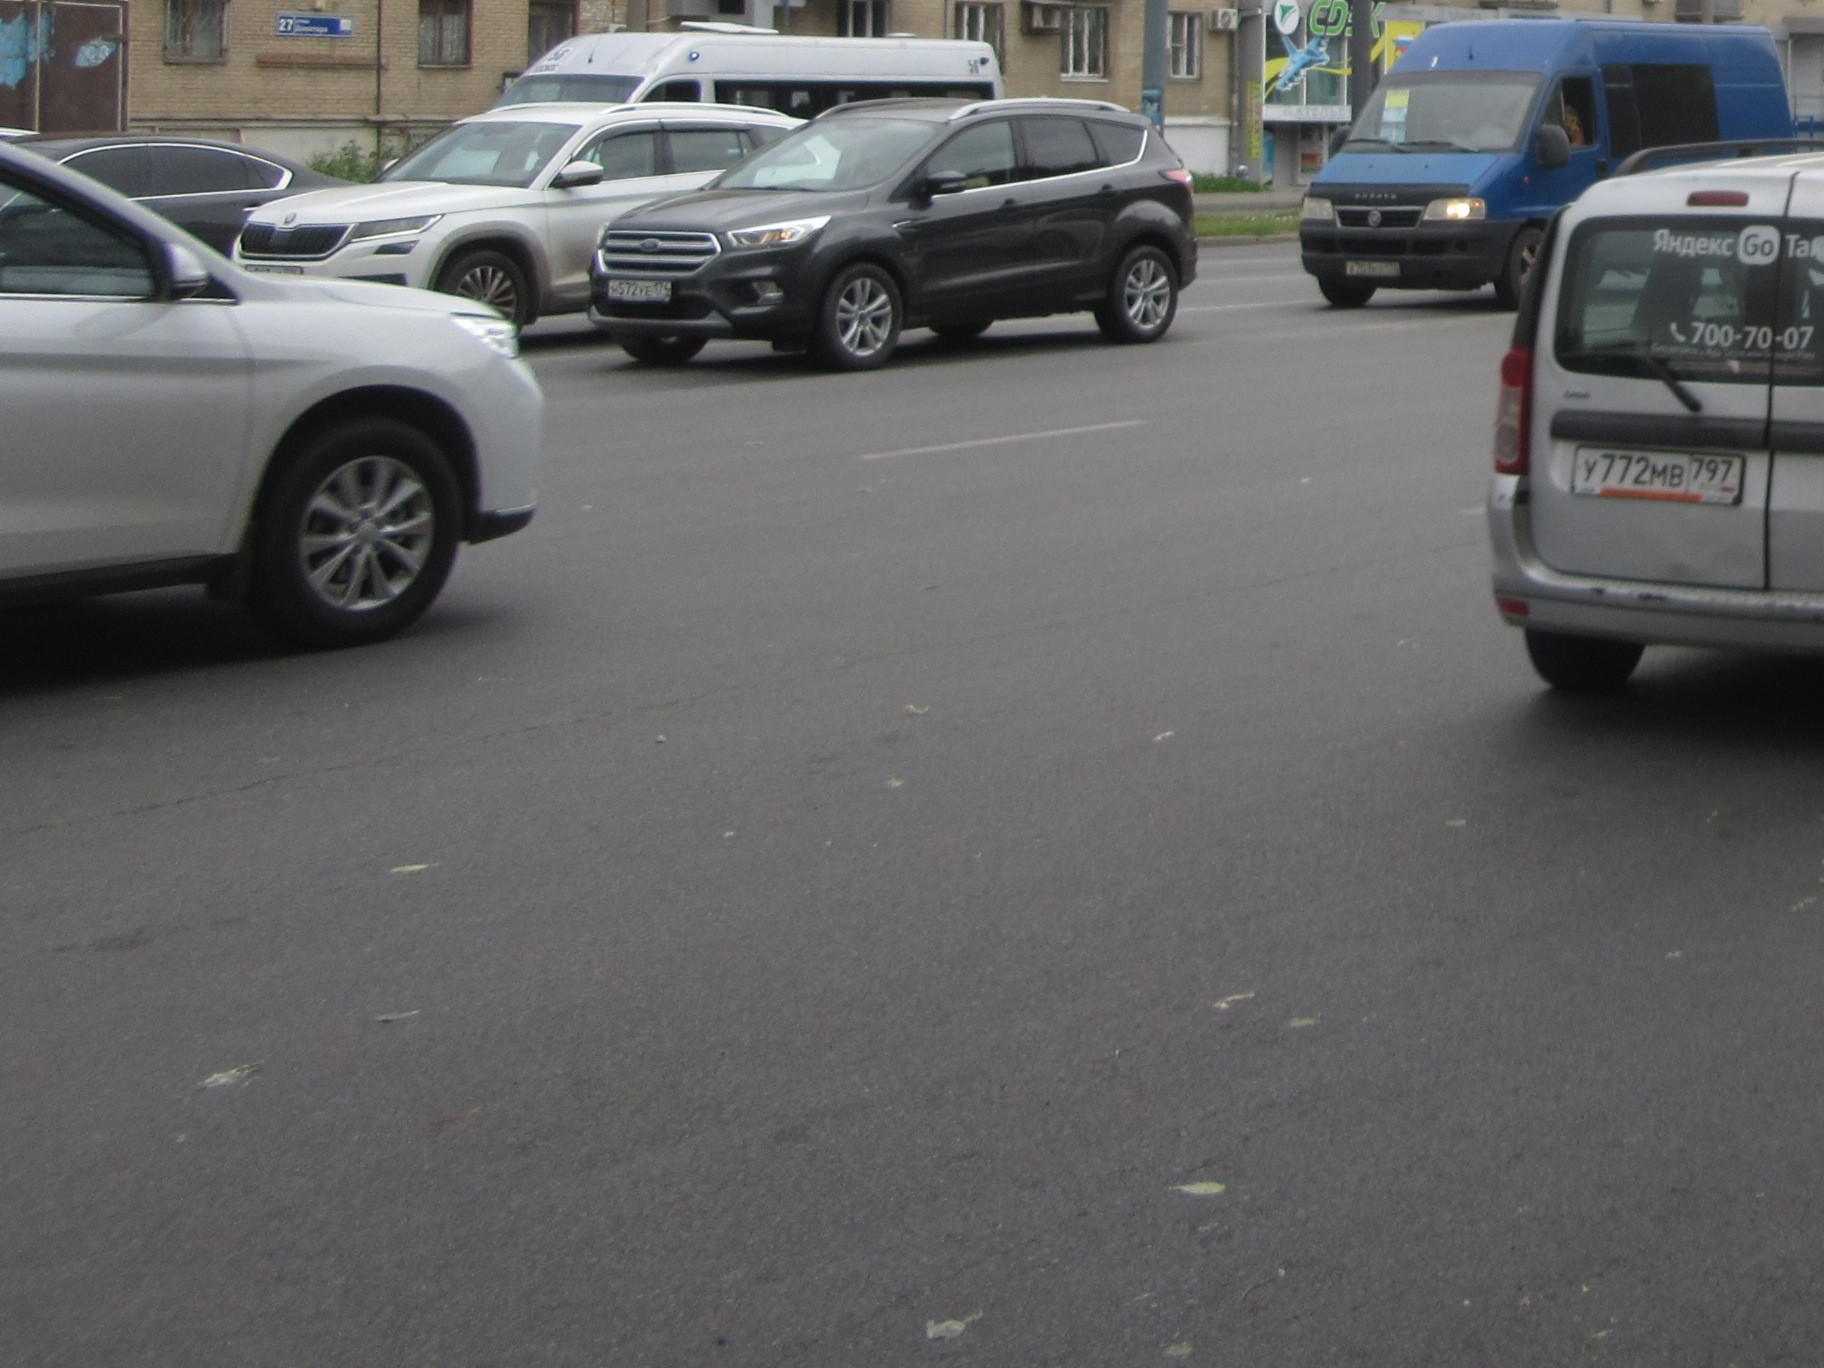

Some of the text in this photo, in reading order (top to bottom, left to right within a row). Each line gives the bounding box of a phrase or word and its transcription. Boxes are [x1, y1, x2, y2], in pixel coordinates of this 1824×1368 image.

[279, 18, 294, 32] 27
[1653, 228, 1735, 258] Яндекс
[1743, 233, 1774, 257] Go
[1690, 322, 1815, 350] 700-70-07
[1584, 453, 1733, 488] У772МВ 797
